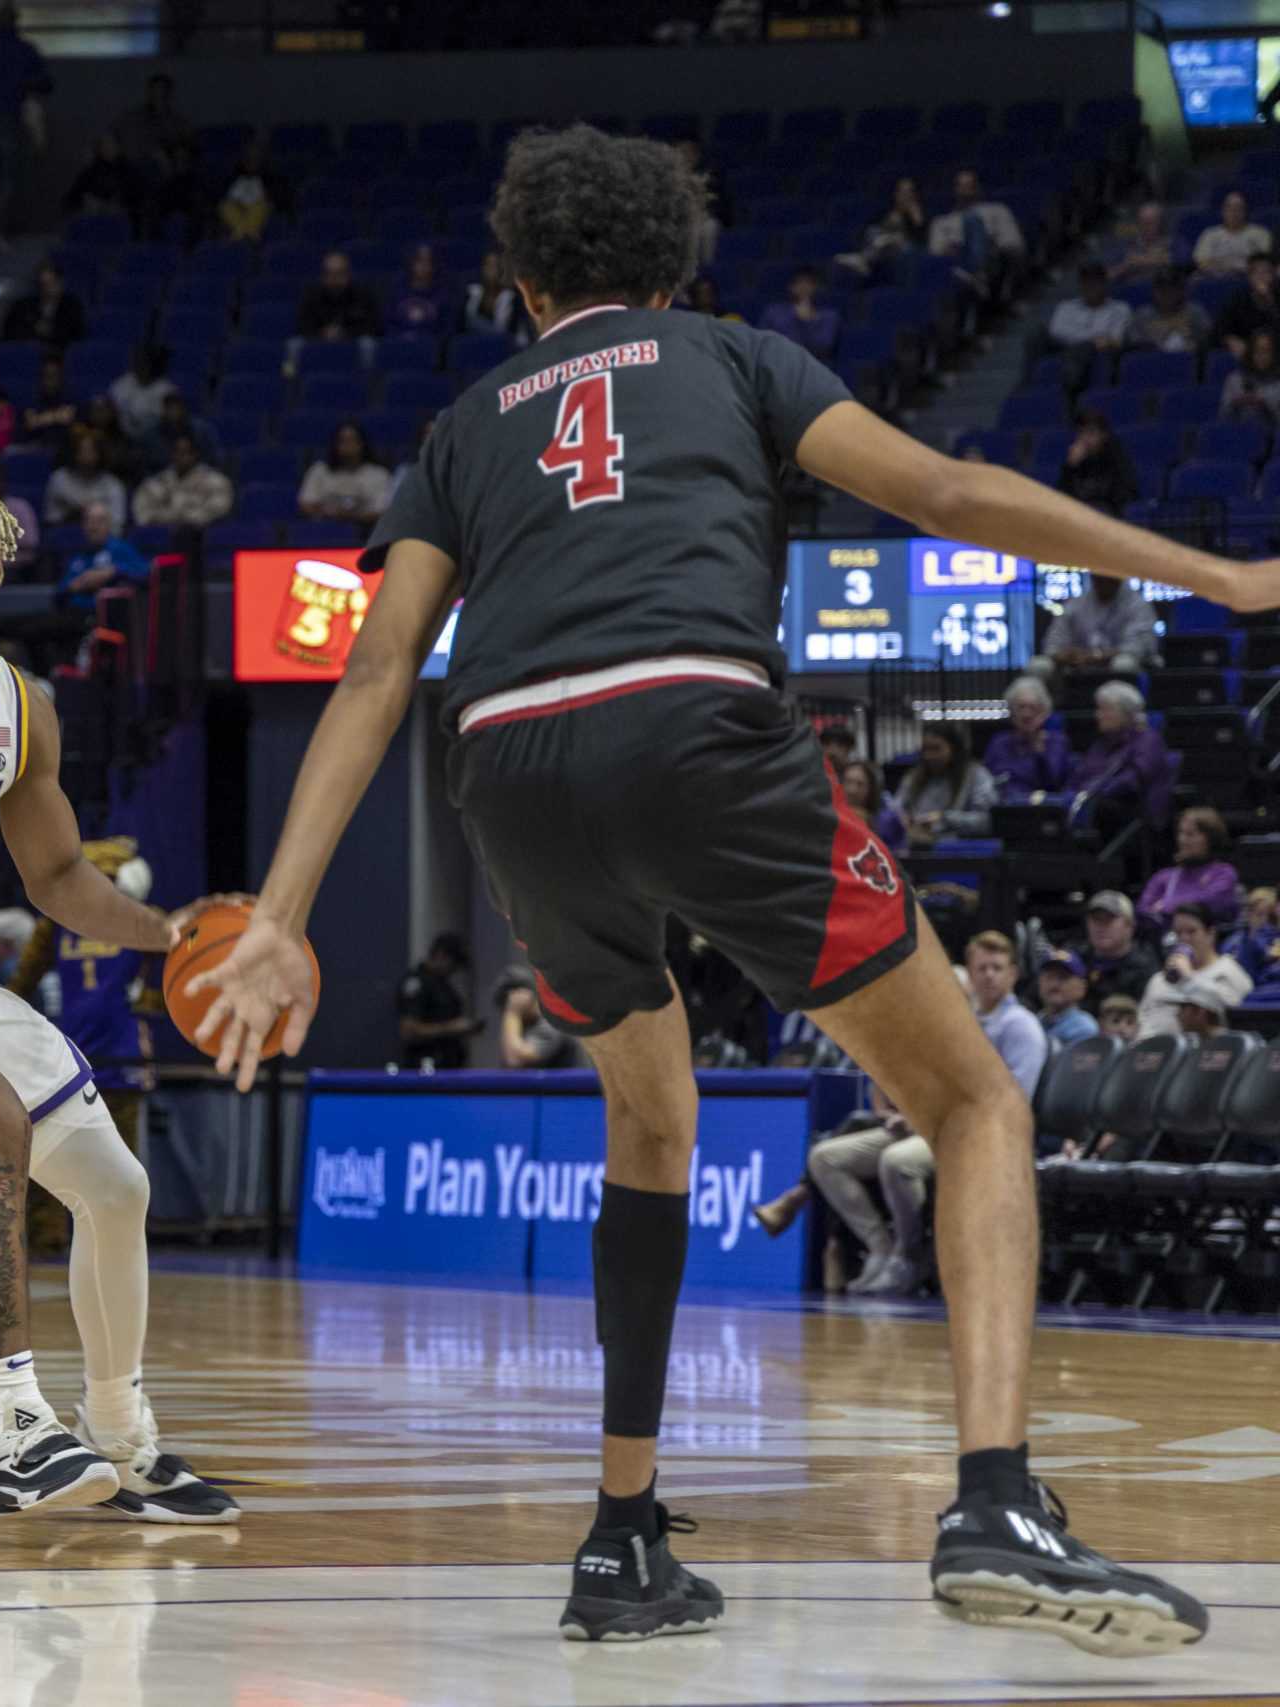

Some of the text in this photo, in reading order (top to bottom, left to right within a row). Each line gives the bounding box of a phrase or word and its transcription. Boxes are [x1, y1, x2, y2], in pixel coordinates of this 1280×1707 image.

[499, 339, 658, 414] BOUTAYEB
[537, 370, 624, 511] 4
[844, 569, 873, 605] 3
[923, 551, 1017, 586] LSU
[932, 602, 1008, 655] 45
[404, 1139, 487, 1217] Plan
[494, 1144, 605, 1221] Yours
